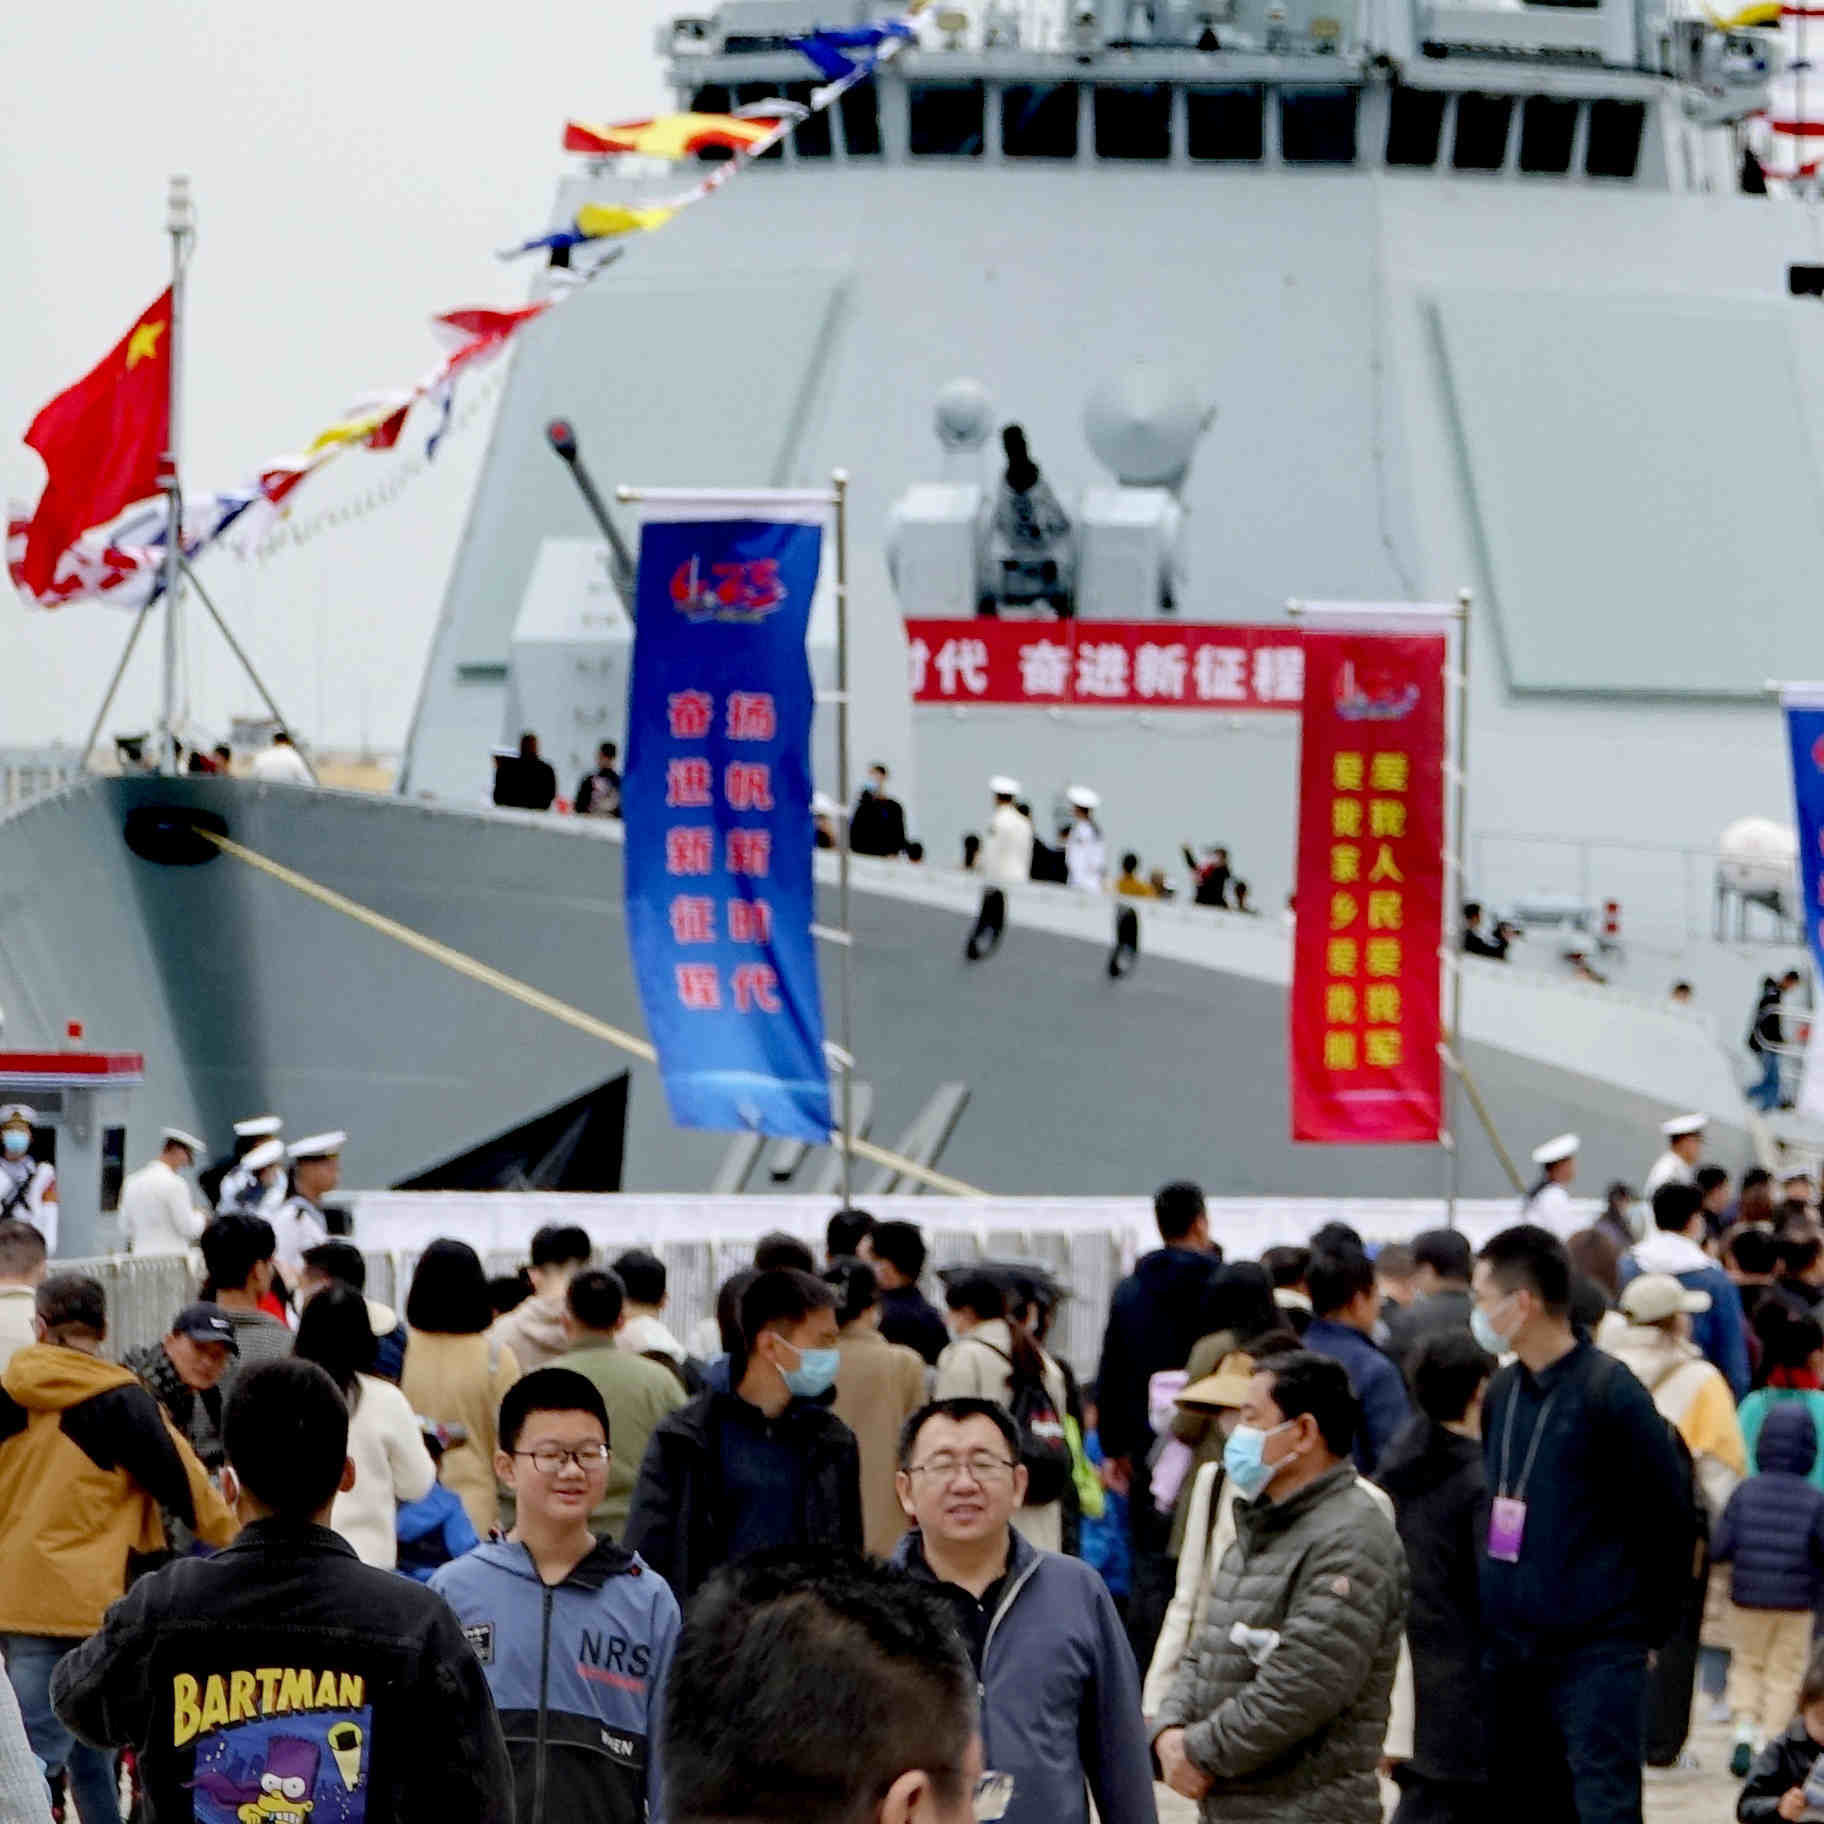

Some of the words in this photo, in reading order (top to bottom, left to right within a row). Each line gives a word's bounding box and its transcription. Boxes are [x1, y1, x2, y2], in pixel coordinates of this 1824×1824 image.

[1018, 638, 1305, 703] 奋进新征程
[579, 1628, 650, 1677] NRS
[173, 1667, 364, 1748] BARTMAN
